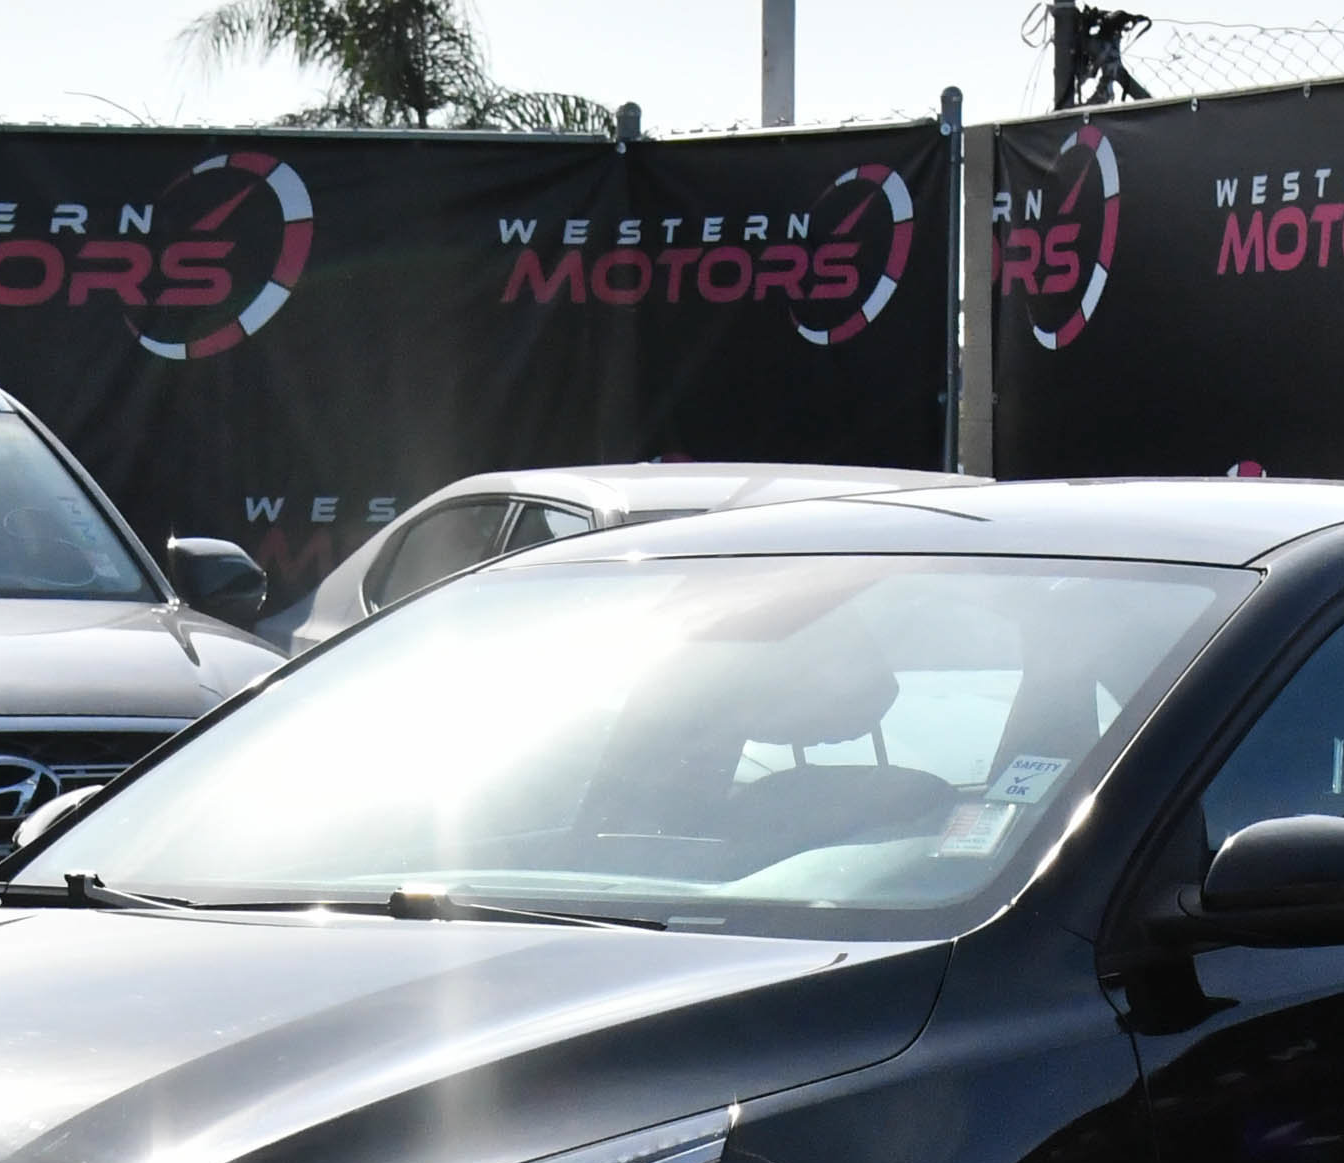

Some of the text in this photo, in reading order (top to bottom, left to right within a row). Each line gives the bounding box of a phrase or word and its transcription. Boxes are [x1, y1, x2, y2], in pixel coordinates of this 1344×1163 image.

[498, 212, 810, 245] WESTERN
[500, 242, 861, 303] MOTORS
[1011, 759, 1062, 773] SAFETY
[1005, 784, 1031, 796] OK
